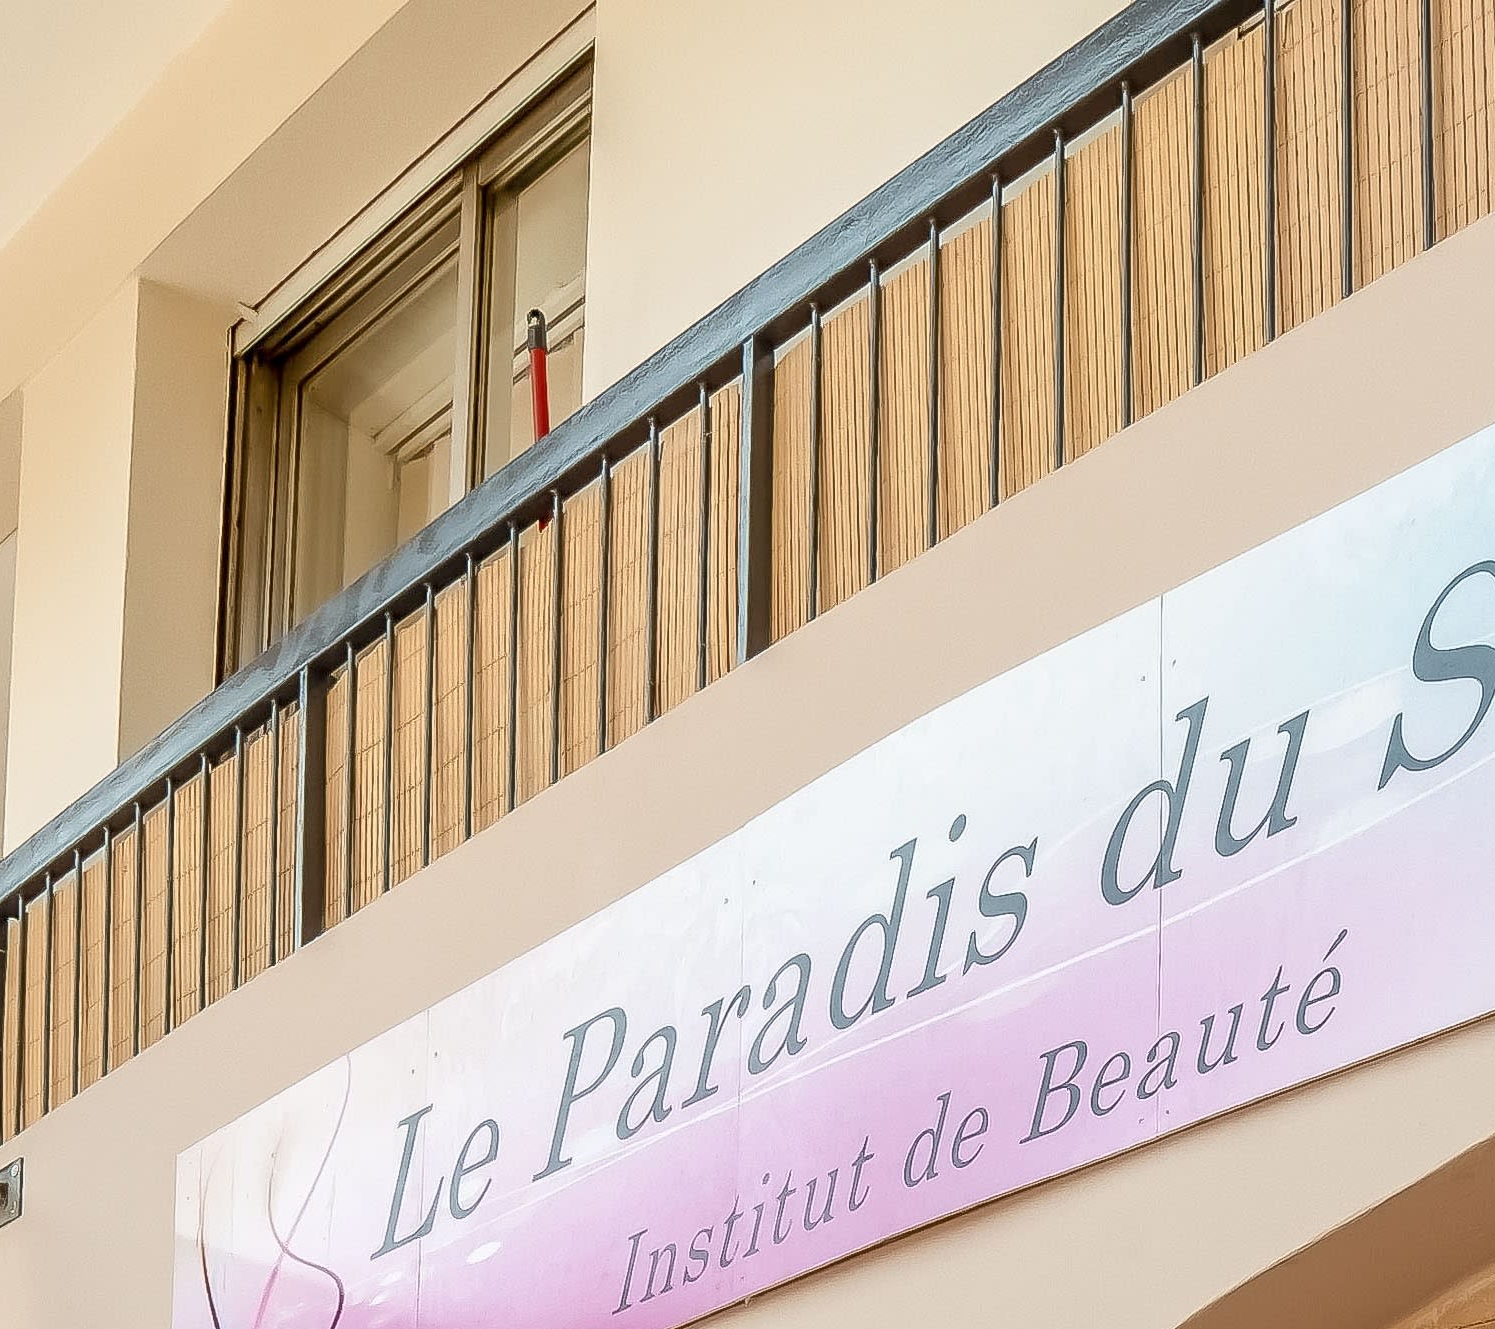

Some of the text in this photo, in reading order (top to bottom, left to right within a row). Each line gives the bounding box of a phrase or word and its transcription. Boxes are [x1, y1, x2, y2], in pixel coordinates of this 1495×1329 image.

[369, 1103, 501, 1261] Le
[532, 812, 1040, 1181] Paradis
[1096, 694, 1311, 908] du
[613, 928, 1346, 1315] Institut de Beauté
